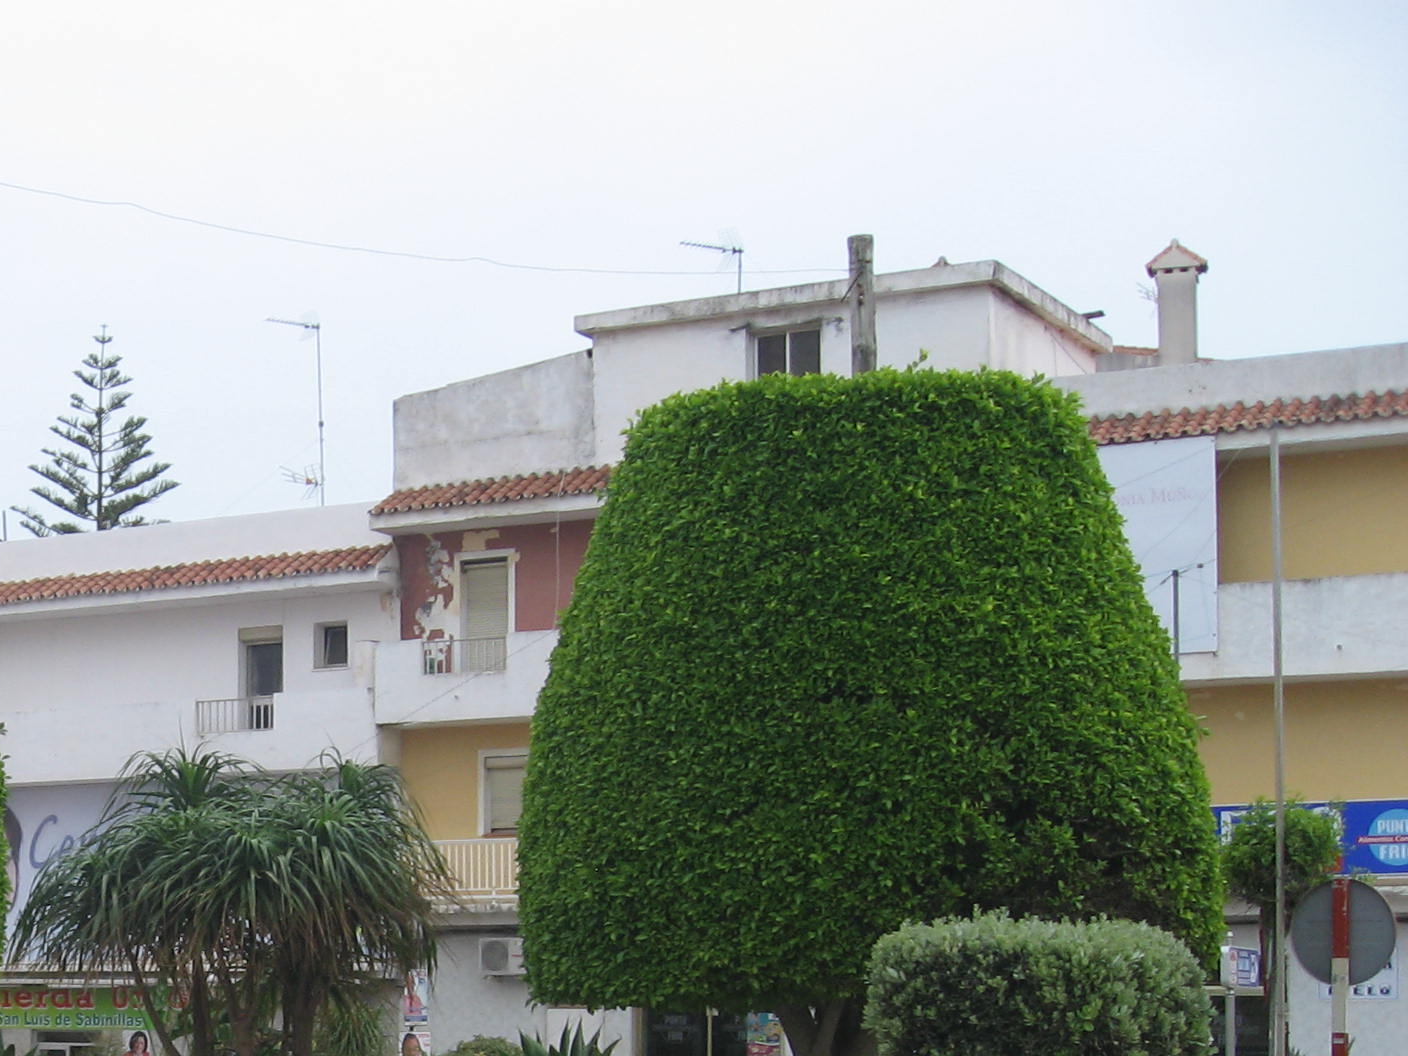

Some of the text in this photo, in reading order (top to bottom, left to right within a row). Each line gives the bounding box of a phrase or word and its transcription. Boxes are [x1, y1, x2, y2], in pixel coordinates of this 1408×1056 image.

[24, 1011, 50, 1026] Luis
[55, 1012, 71, 1026] de
[75, 1012, 142, 1027] Sabinillas
